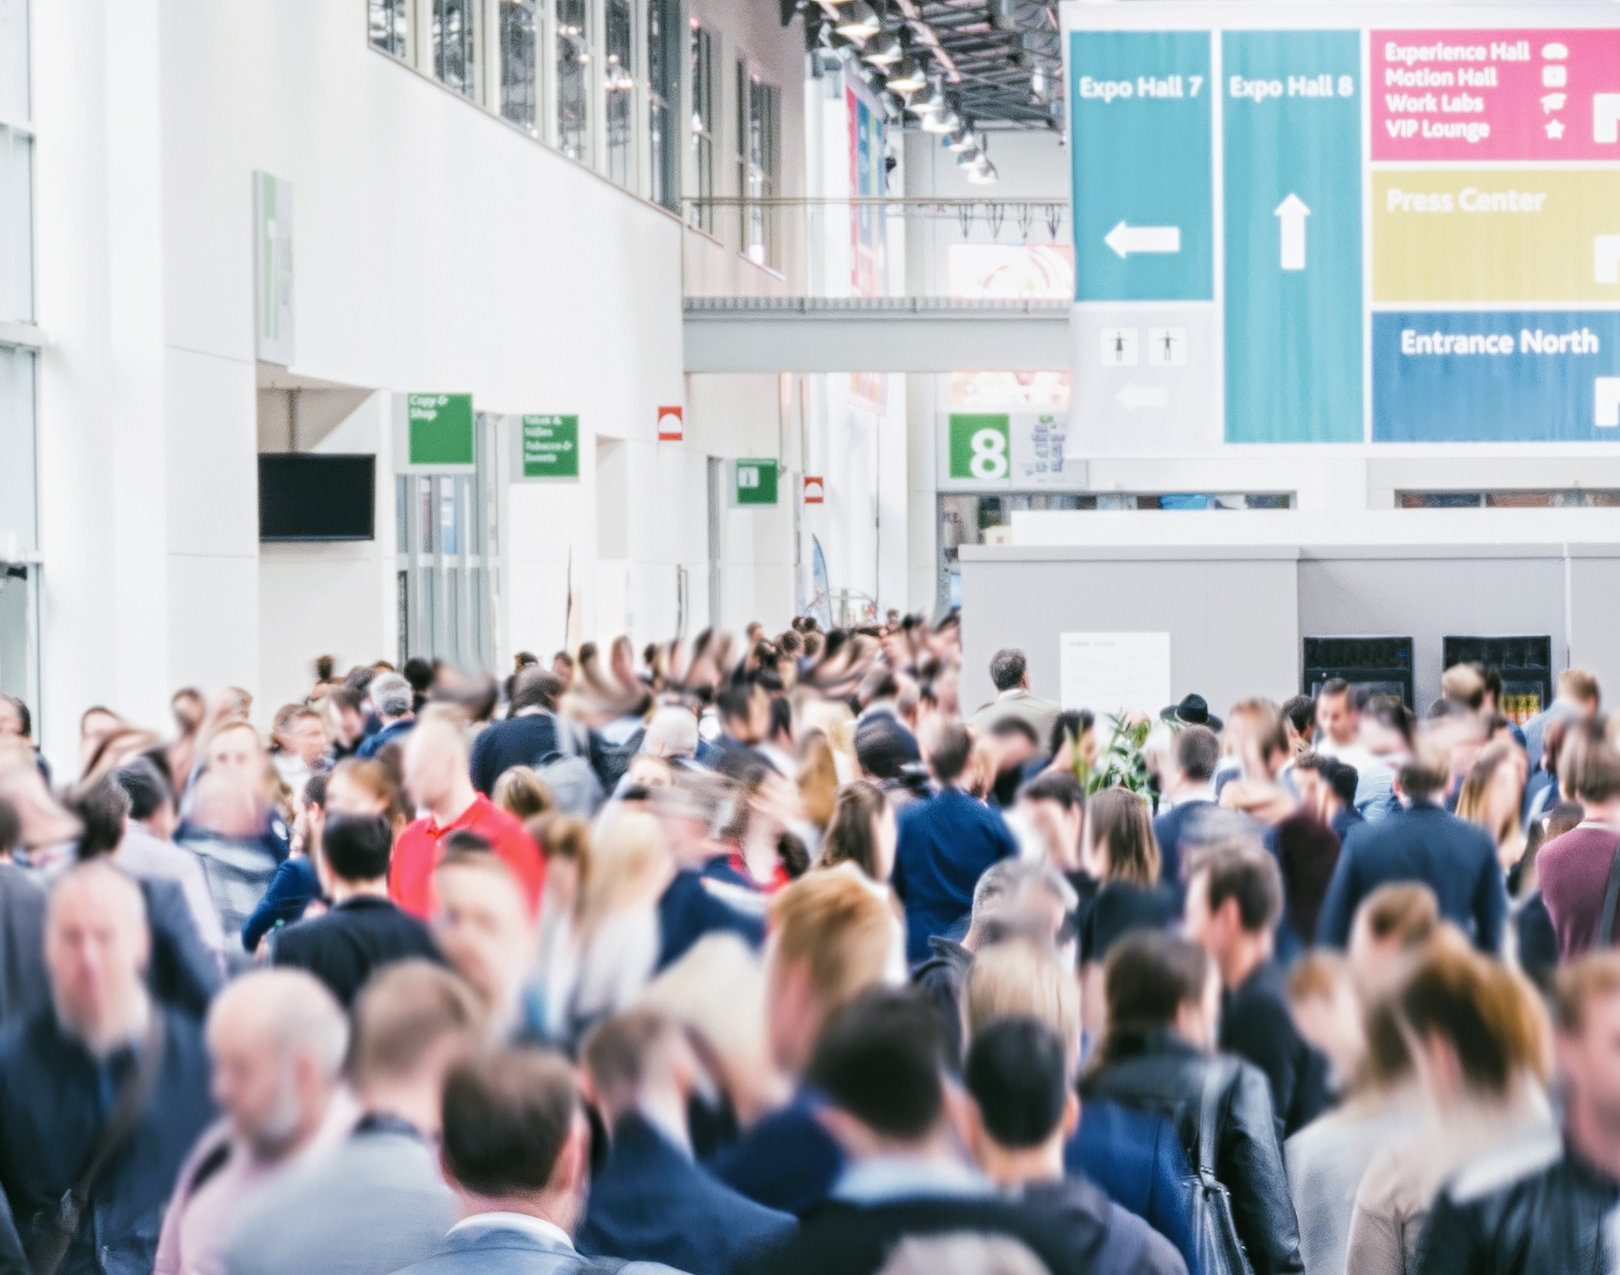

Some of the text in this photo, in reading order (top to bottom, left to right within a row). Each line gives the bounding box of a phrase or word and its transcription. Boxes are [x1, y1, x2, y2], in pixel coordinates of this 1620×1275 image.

[1385, 42, 1530, 63] Experience Hall
[1385, 66, 1497, 87] Motion Hall
[1080, 75, 1203, 103] Expo Hall 7
[1230, 75, 1354, 103] Expo Hall 8
[1385, 92, 1484, 113] Work Labs
[1386, 119, 1490, 141] VIP Lounge
[1386, 187, 1546, 213] Press Center
[1401, 328, 1599, 355] Entrance North
[410, 394, 448, 407] Copy &
[970, 428, 1008, 480] 8
